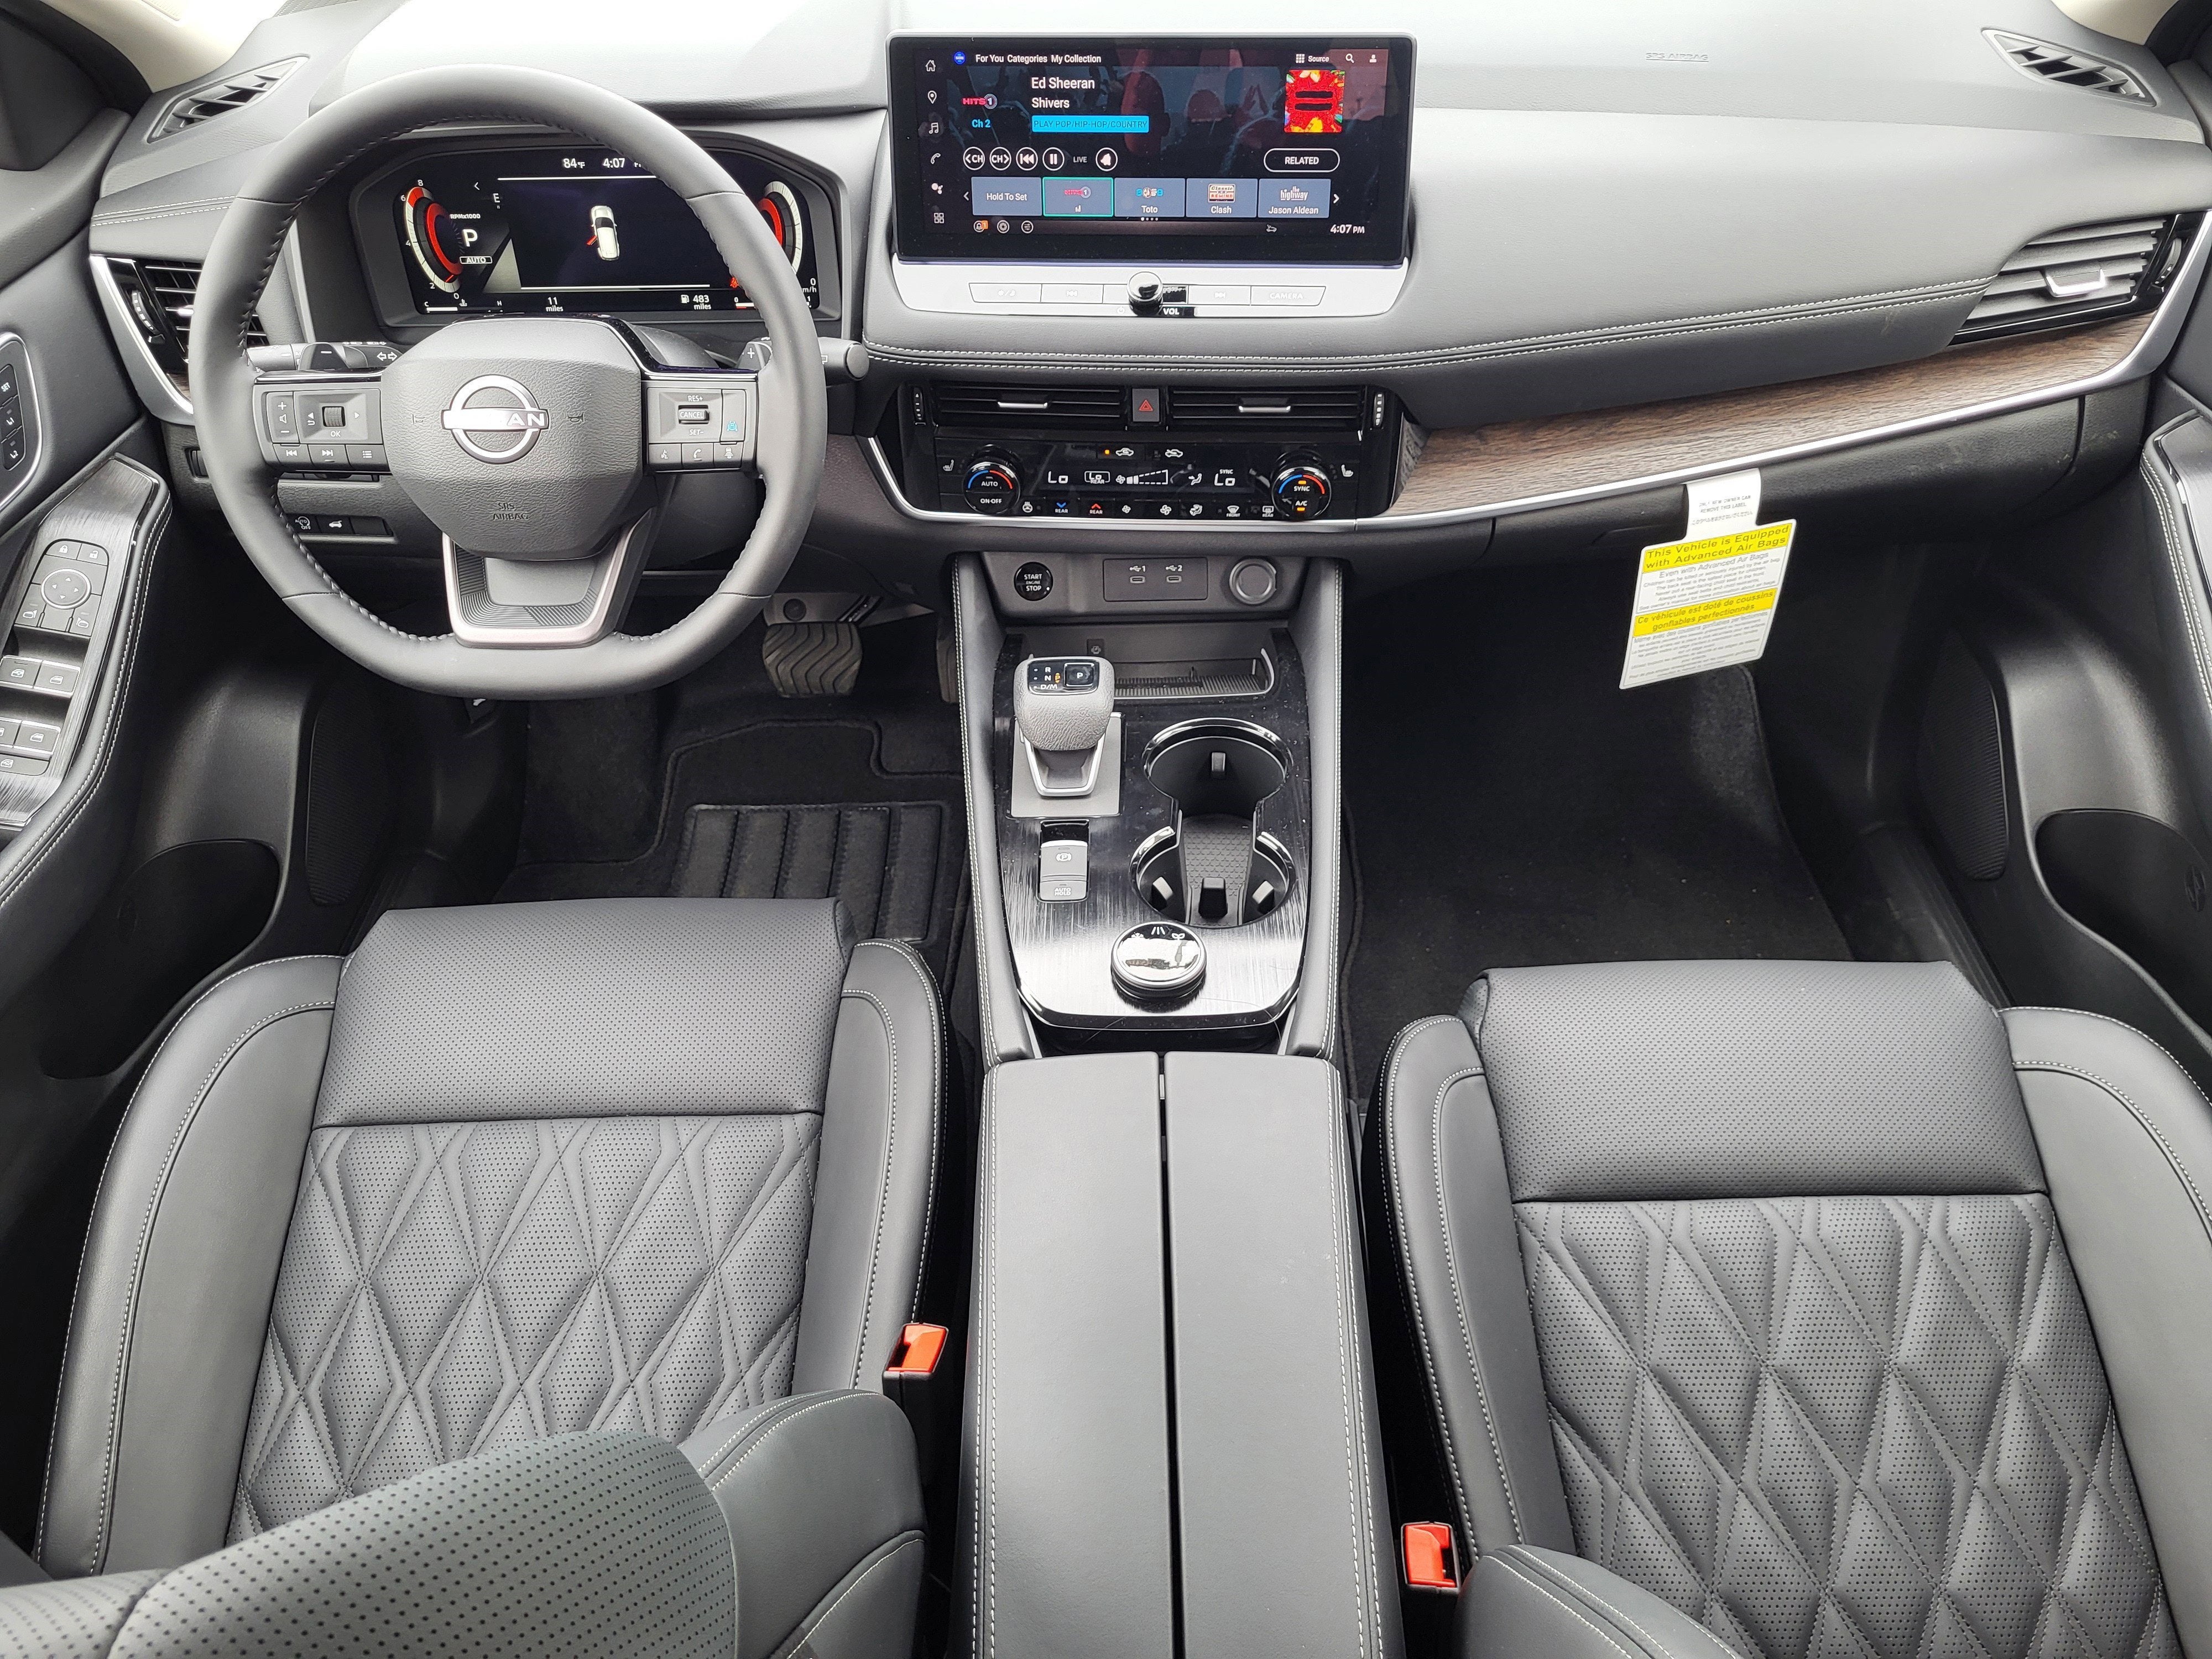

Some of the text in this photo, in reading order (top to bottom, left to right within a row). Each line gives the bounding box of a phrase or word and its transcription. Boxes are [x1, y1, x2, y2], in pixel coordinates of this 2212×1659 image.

[975, 54, 1102, 64] For You Categories My Collection
[1031, 77, 1095, 89] Ed Sheeran
[1031, 98, 1070, 108] Shivers
[972, 118, 991, 128] Ch 2
[603, 158, 625, 168] 4:07
[1285, 156, 1319, 165] RELATED
[1015, 192, 1027, 201] Set
[1280, 189, 1308, 201] highway
[1293, 206, 1318, 215] Aldean
[1330, 224, 1352, 234] 4:07
[462, 228, 478, 247] P
[810, 278, 816, 286] 0
[547, 296, 558, 305] 11
[693, 295, 709, 303] 483
[1, 382, 11, 392] SET
[1048, 471, 1068, 483] Lo
[1214, 473, 1235, 486] Lo
[498, 502, 515, 510] SRS
[1648, 549, 1671, 559] This
[1676, 541, 1718, 553] Vehicle
[1735, 525, 1789, 542] Equipped
[1646, 537, 1786, 568] with Advanced Air Bags
[1688, 605, 1702, 614] est
[1736, 592, 1773, 604] coussins
